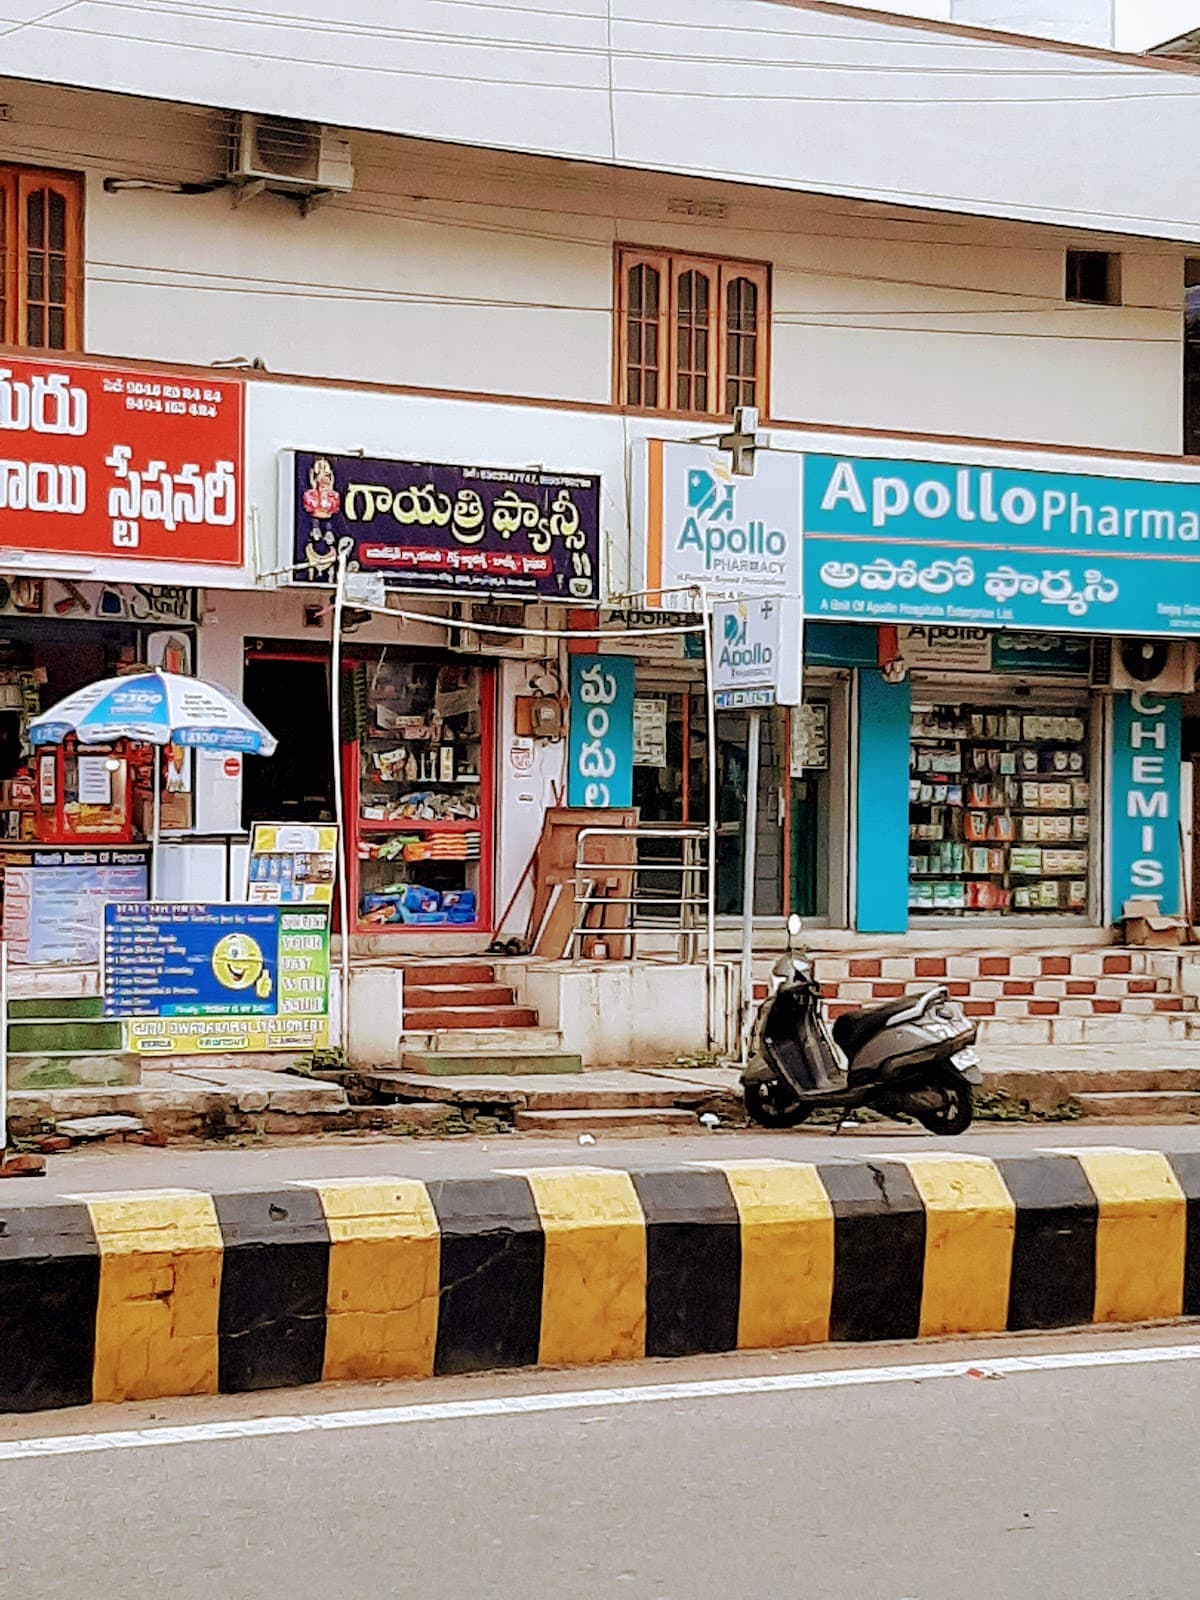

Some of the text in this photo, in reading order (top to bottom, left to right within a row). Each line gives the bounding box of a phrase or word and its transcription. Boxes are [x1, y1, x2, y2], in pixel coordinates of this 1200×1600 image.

[344, 483, 486, 544] గాయత్రి
[820, 462, 1200, 541] Apollo Pharma
[677, 517, 786, 570] Apollo
[713, 558, 785, 574] PHARMACY
[819, 556, 975, 594] అపోలో
[1127, 691, 1169, 900] CHEMIS
